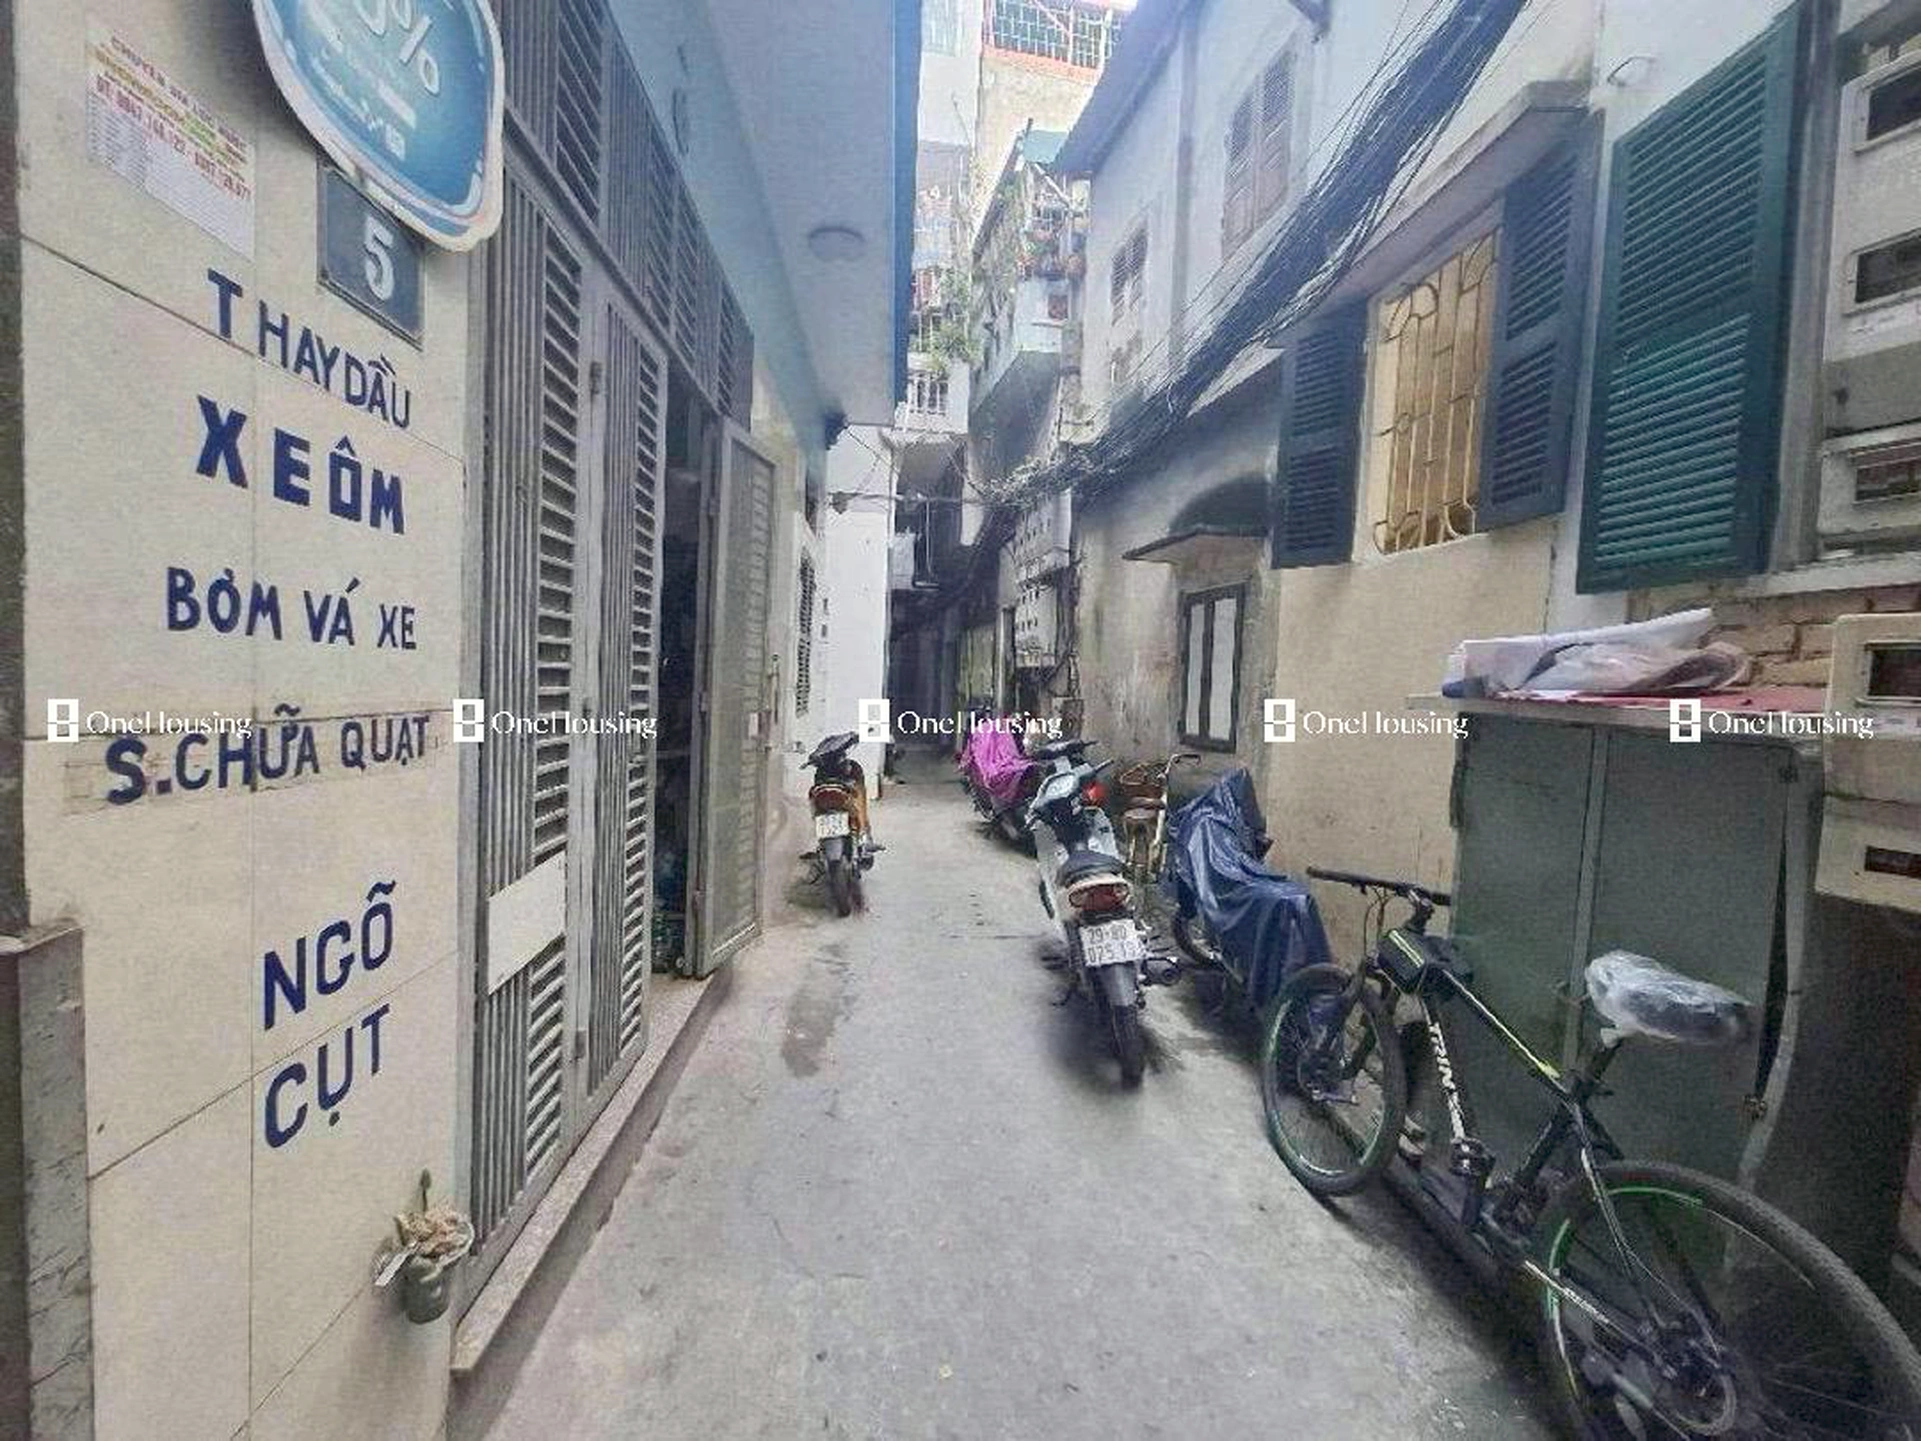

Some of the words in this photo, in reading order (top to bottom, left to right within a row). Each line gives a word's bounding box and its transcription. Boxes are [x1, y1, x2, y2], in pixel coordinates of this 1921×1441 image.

[363, 216, 396, 300] 5
[196, 394, 311, 507] XE
[328, 436, 405, 535] ÔM
[303, 577, 361, 647] VÁ
[377, 605, 417, 651] XE
[340, 715, 430, 768] QUẠT
[264, 879, 397, 1032] NGÕ
[264, 1003, 390, 1149] CỤT
